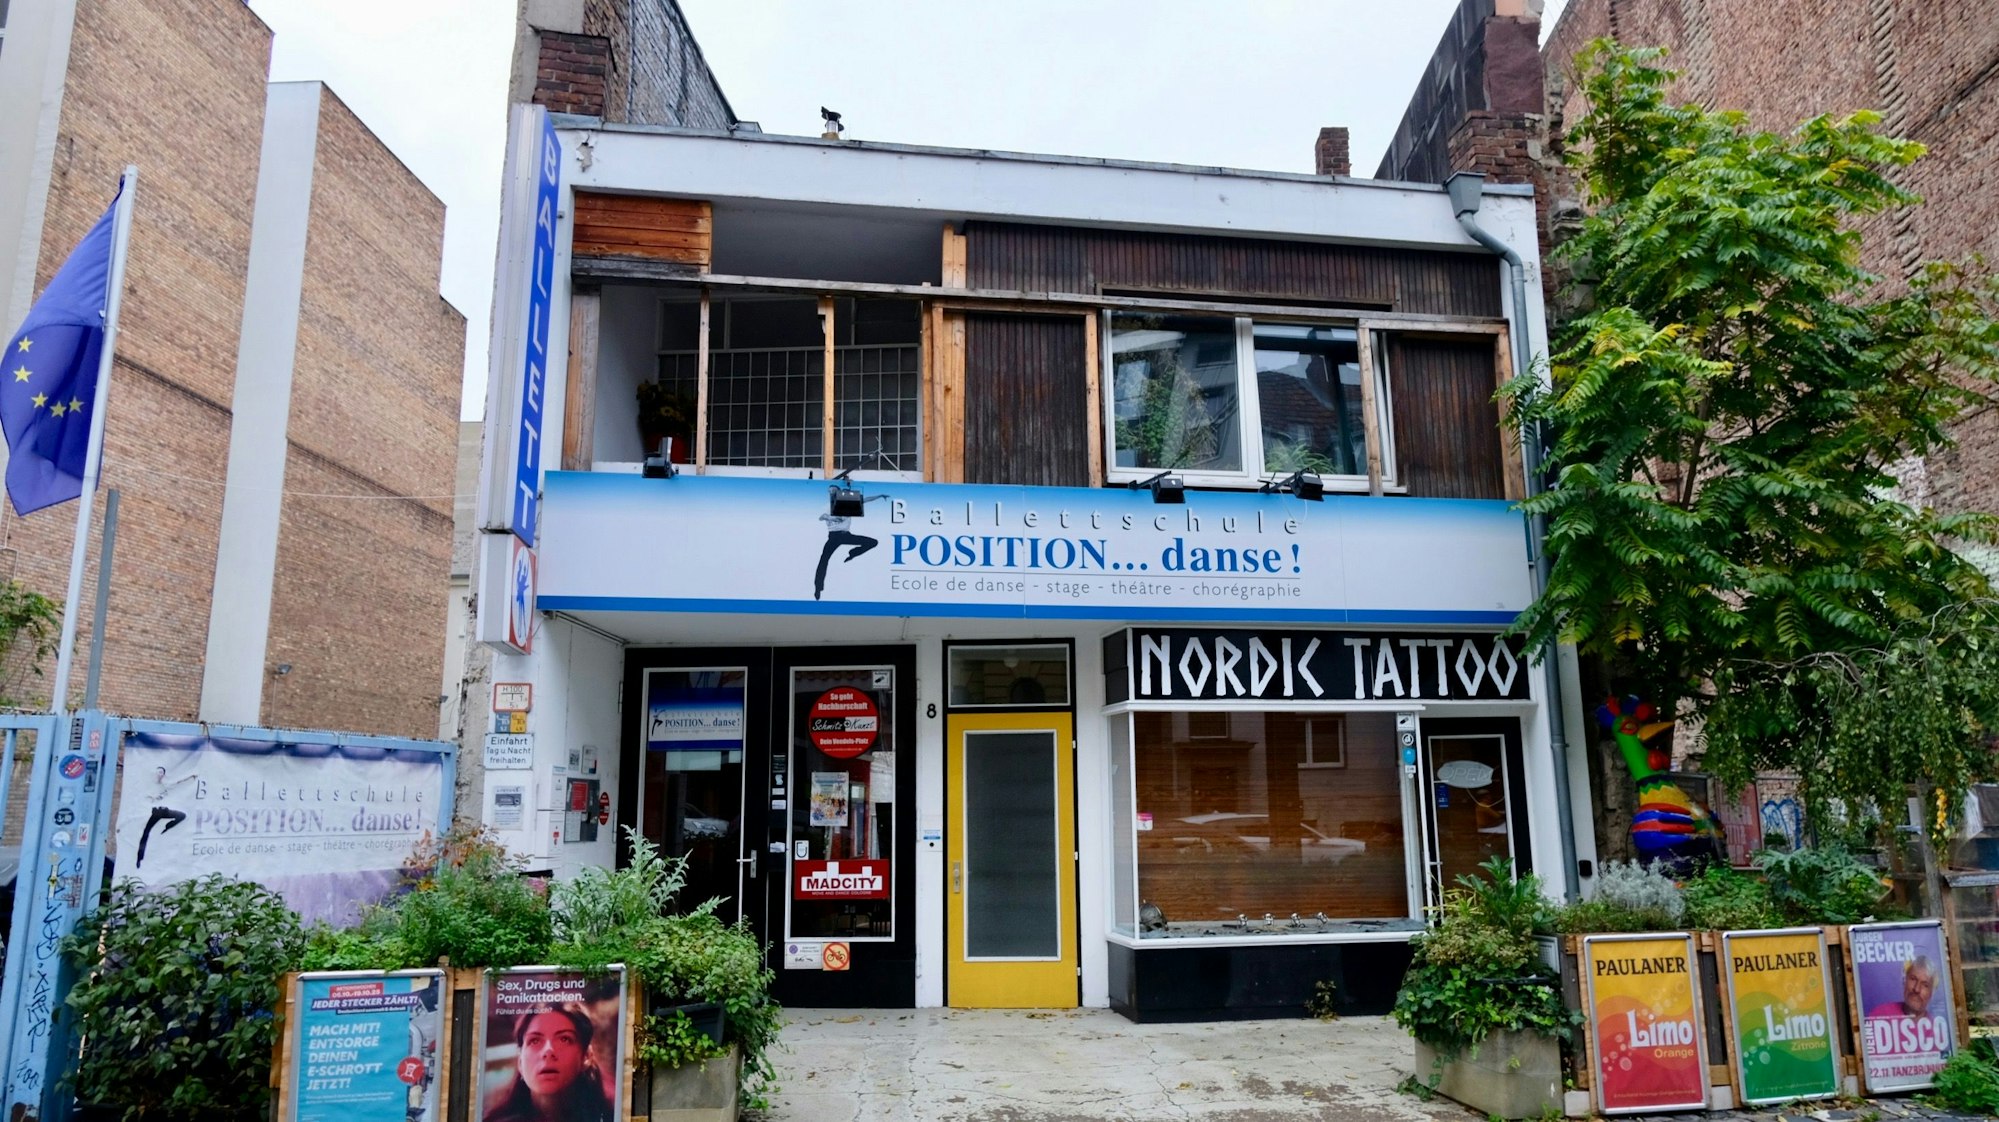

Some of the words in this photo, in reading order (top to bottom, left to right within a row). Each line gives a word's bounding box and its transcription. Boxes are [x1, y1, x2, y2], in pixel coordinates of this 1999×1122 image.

[519, 132, 557, 529] BALLETT
[890, 498, 1300, 535] Ballettschule
[890, 533, 1149, 572] POSITION...
[890, 575, 939, 591] Ecole
[946, 576, 967, 591] de
[974, 577, 1025, 592] danse
[1046, 580, 1090, 598] stage
[1111, 579, 1172, 596] théâtre
[1192, 582, 1301, 601] chorégraphie
[1140, 634, 1325, 698] NORDIC
[1343, 637, 1519, 699] TATTOO
[839, 693, 854, 701] geht
[818, 702, 868, 711] Nachbarschaft
[926, 703, 937, 719] 8
[490, 736, 528, 746] Einfahrt
[486, 746, 500, 756] Tag
[507, 746, 531, 754] Nacht
[489, 756, 527, 764] freihalten
[195, 778, 424, 803] Ballettschule
[193, 806, 345, 836] POSITION...
[351, 805, 422, 833] danse!
[192, 842, 225, 857] Ecole
[227, 841, 242, 855] de
[244, 840, 276, 855] danse
[287, 840, 313, 855] stage
[806, 877, 877, 890] MADCITY
[1855, 940, 1917, 964] BECKER
[1595, 956, 1688, 976] PAULANER
[1732, 951, 1818, 974] PAULANER
[496, 980, 523, 992] Sex,
[524, 979, 561, 992] Drugs
[562, 978, 585, 989] und
[312, 999, 341, 1009] JEDER
[341, 997, 383, 1007] STECKER
[384, 994, 419, 1005] ZÄHLT!
[496, 991, 586, 1004] Panikattacken.
[309, 1023, 349, 1037] MACH
[351, 1022, 382, 1034] MIT!
[1626, 1008, 1694, 1048] Limo
[1763, 1004, 1826, 1042] Limo
[1873, 1015, 1950, 1054] DISCO
[308, 1035, 380, 1050] ENTSORGE
[1791, 1040, 1827, 1051] Zitrone
[307, 1050, 359, 1064] DEINEN
[1654, 1048, 1694, 1059] Orange
[306, 1077, 352, 1091] JETZT!
